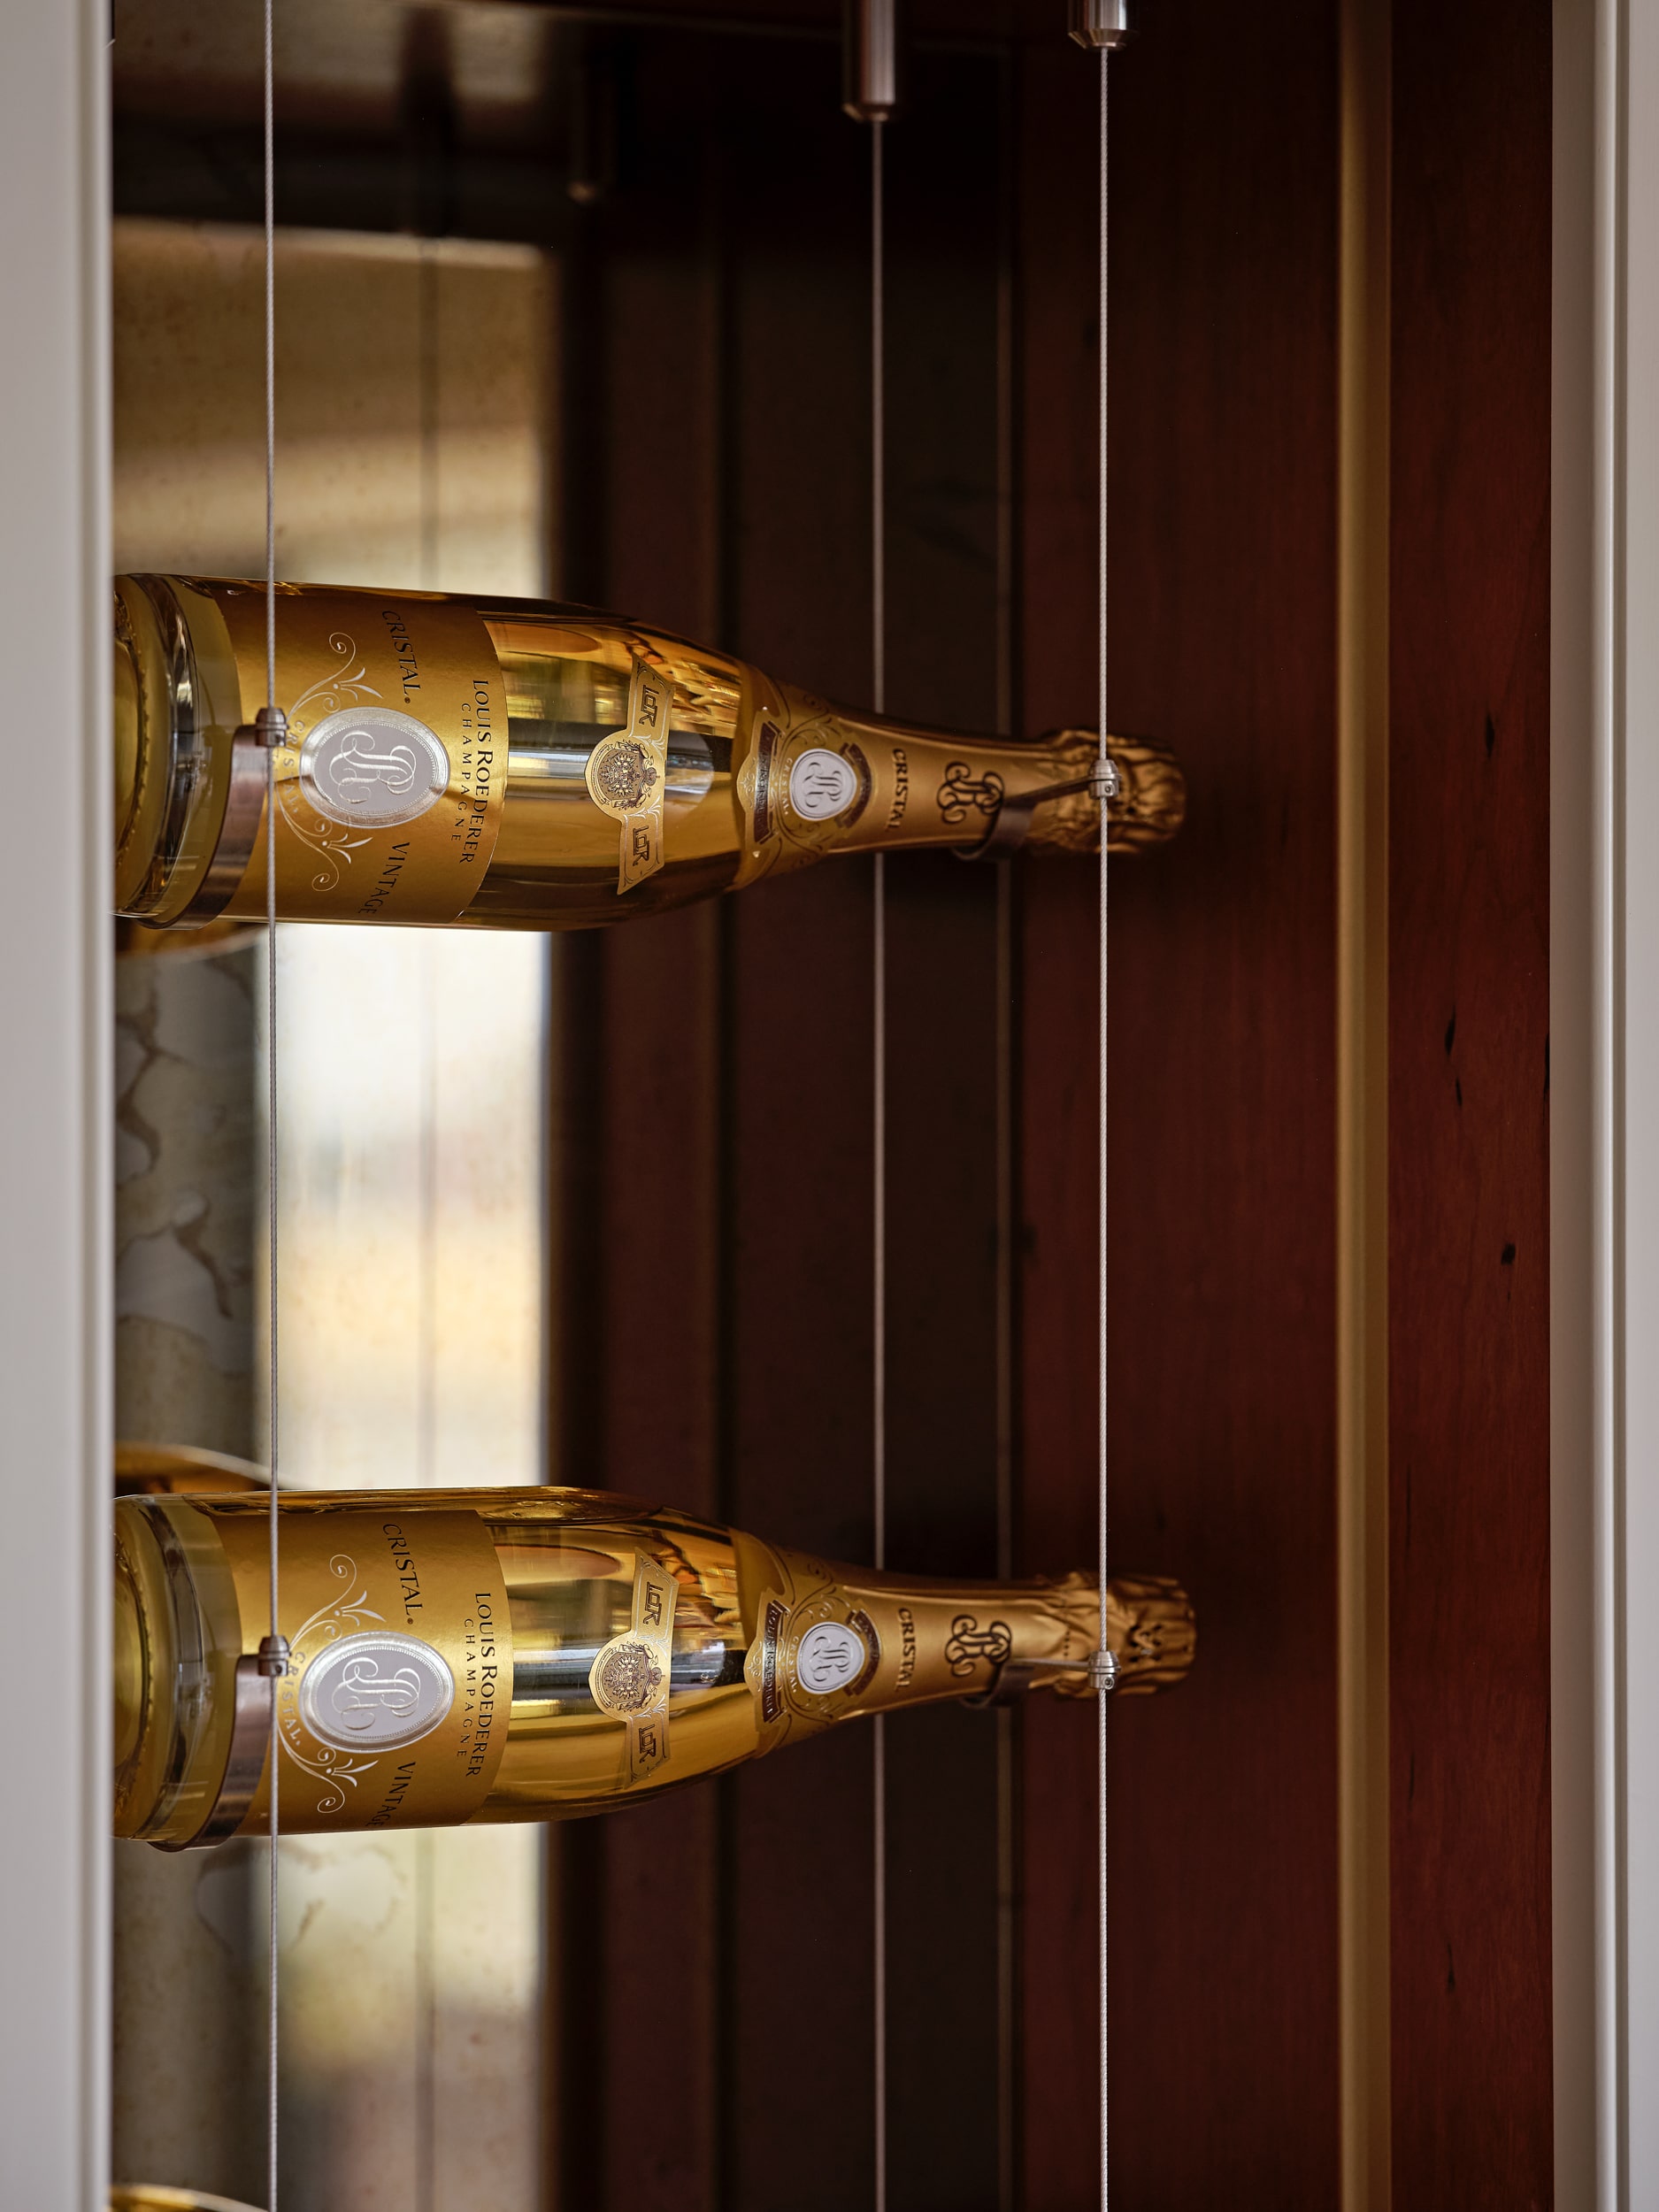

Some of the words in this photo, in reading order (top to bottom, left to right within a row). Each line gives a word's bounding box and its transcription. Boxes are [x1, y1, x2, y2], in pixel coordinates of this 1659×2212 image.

[472, 679, 493, 742] LOUIS
[450, 703, 472, 841] CHAMPAGNE
[458, 749, 494, 864] ROEDERER
[885, 747, 910, 832] CRISTAL
[357, 841, 411, 915] VINTAGE
[475, 1593, 495, 1657] LOUIS
[894, 1607, 917, 1694] CRISTAL
[456, 1618, 477, 1758] CHAMPAGNE
[465, 1663, 497, 1778] ROEDERER
[365, 1760, 417, 1828] VINTAGE
